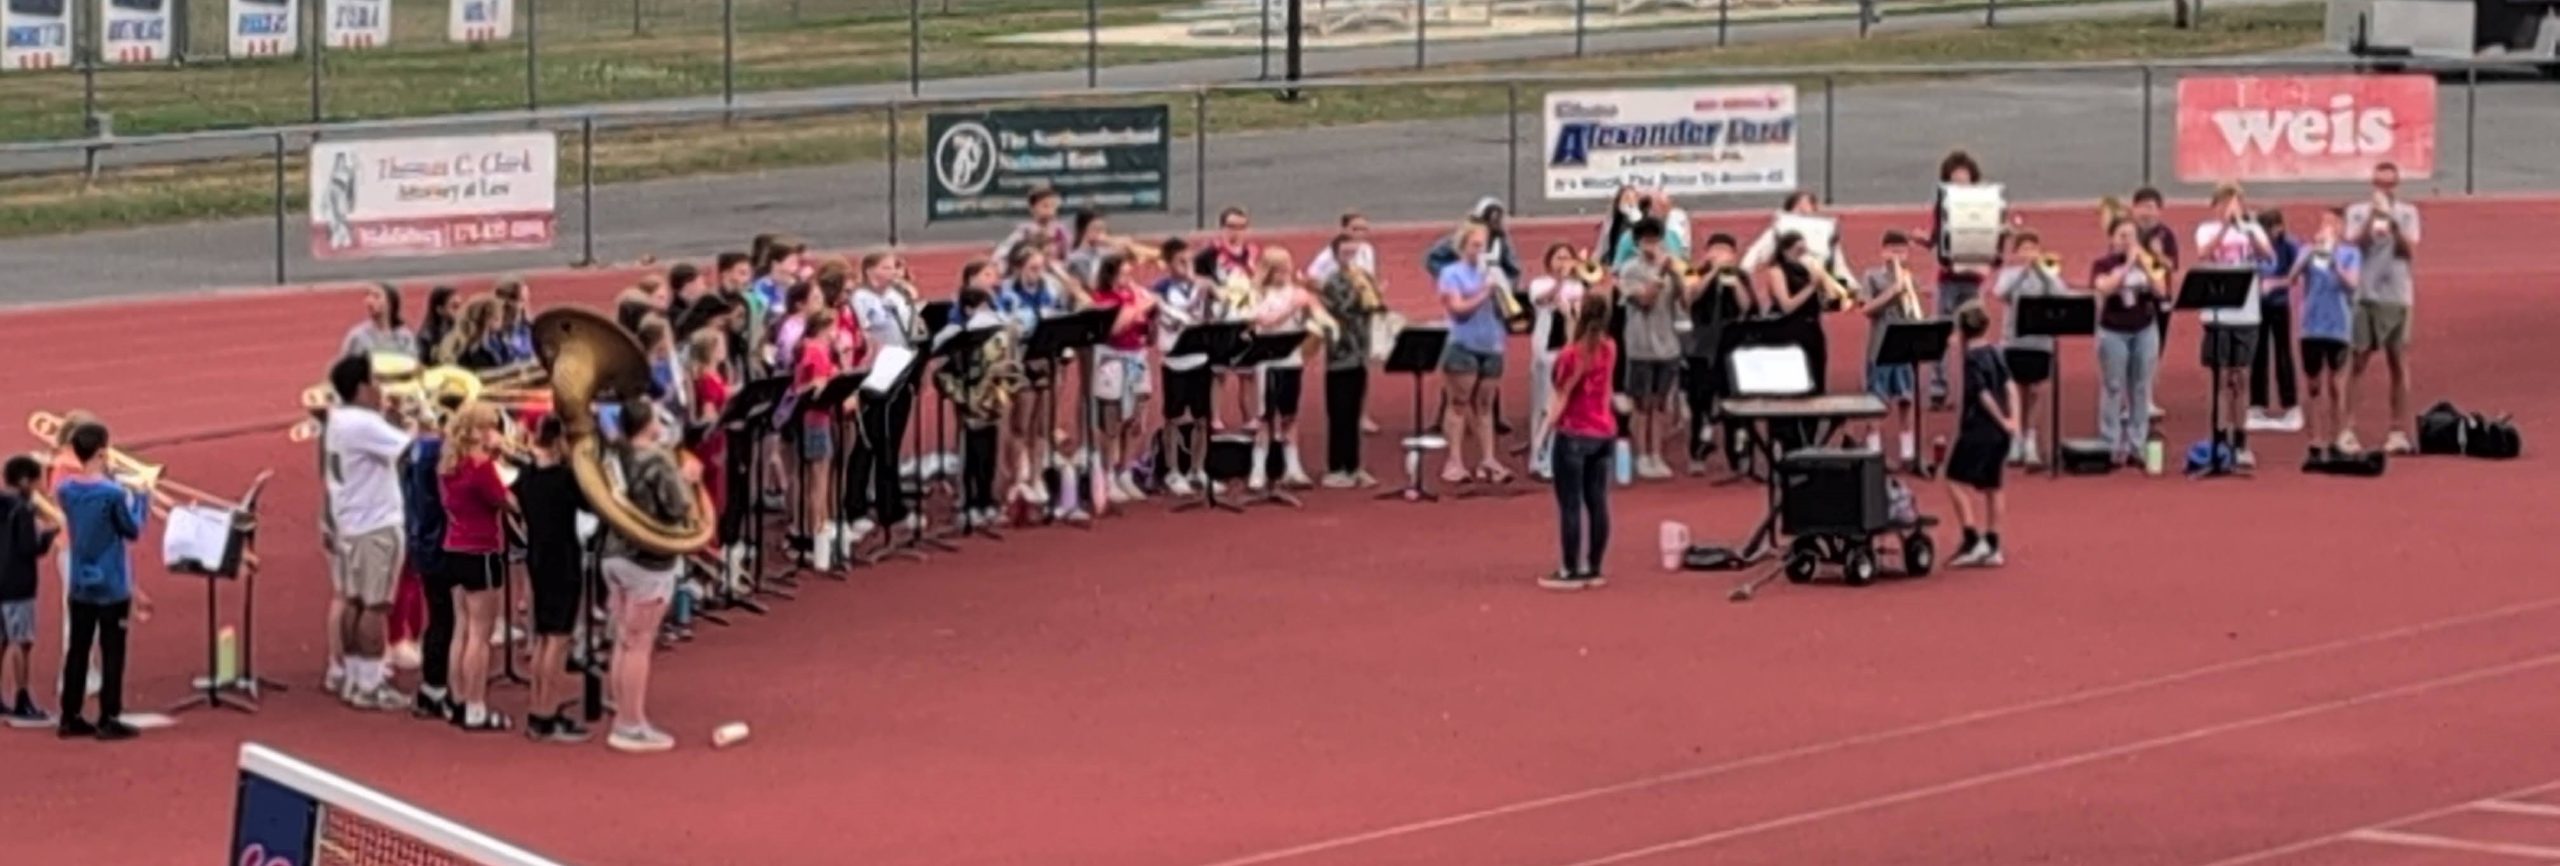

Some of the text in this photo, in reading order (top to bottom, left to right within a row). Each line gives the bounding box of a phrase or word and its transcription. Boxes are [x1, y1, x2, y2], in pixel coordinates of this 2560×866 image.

[2210, 93, 2399, 156] weis
[999, 131, 1028, 150] The
[1549, 115, 1795, 168] Alexander Ford
[998, 148, 1108, 171] National Bank
[1627, 171, 1655, 188] The
